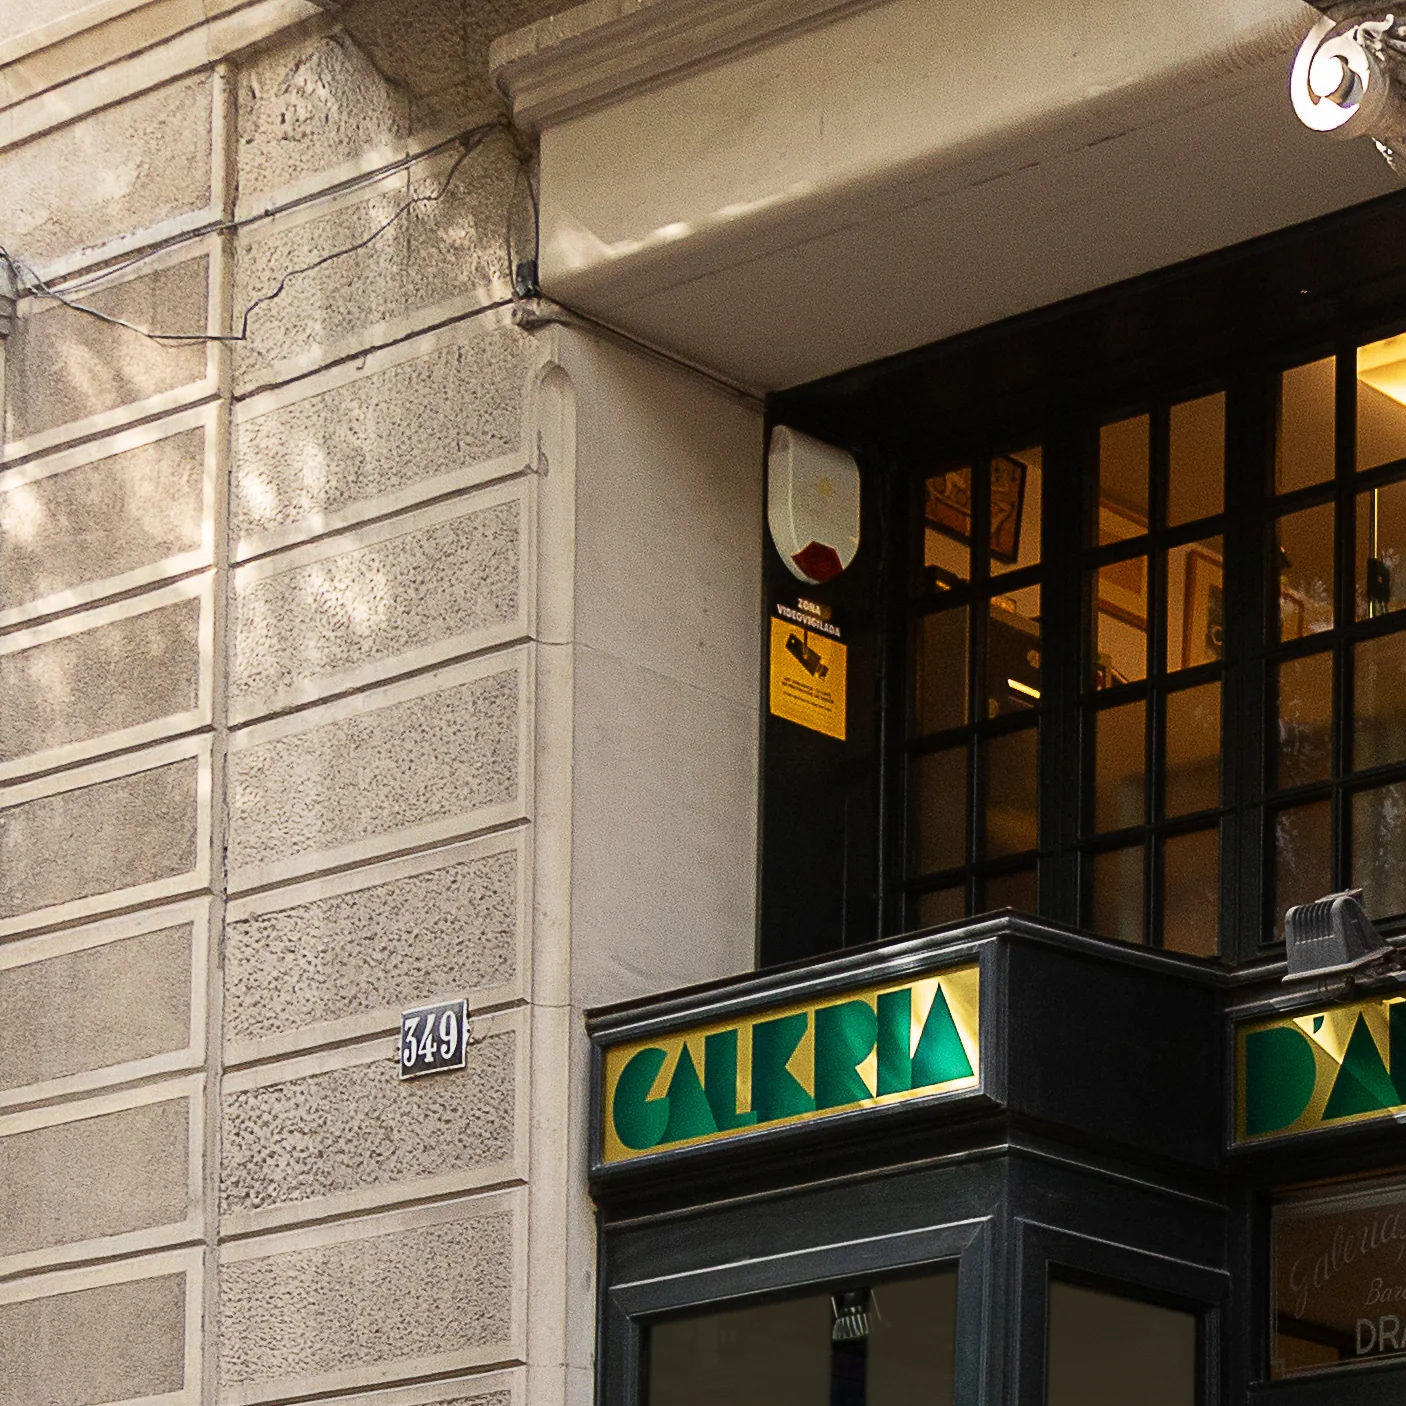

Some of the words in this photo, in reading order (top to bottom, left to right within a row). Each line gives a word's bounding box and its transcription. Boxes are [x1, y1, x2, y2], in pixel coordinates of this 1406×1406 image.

[776, 603, 841, 637] VIDEOVIGILADA
[797, 598, 821, 615] ZONA
[402, 1010, 458, 1067] 349
[612, 981, 975, 1151] GALERIA
